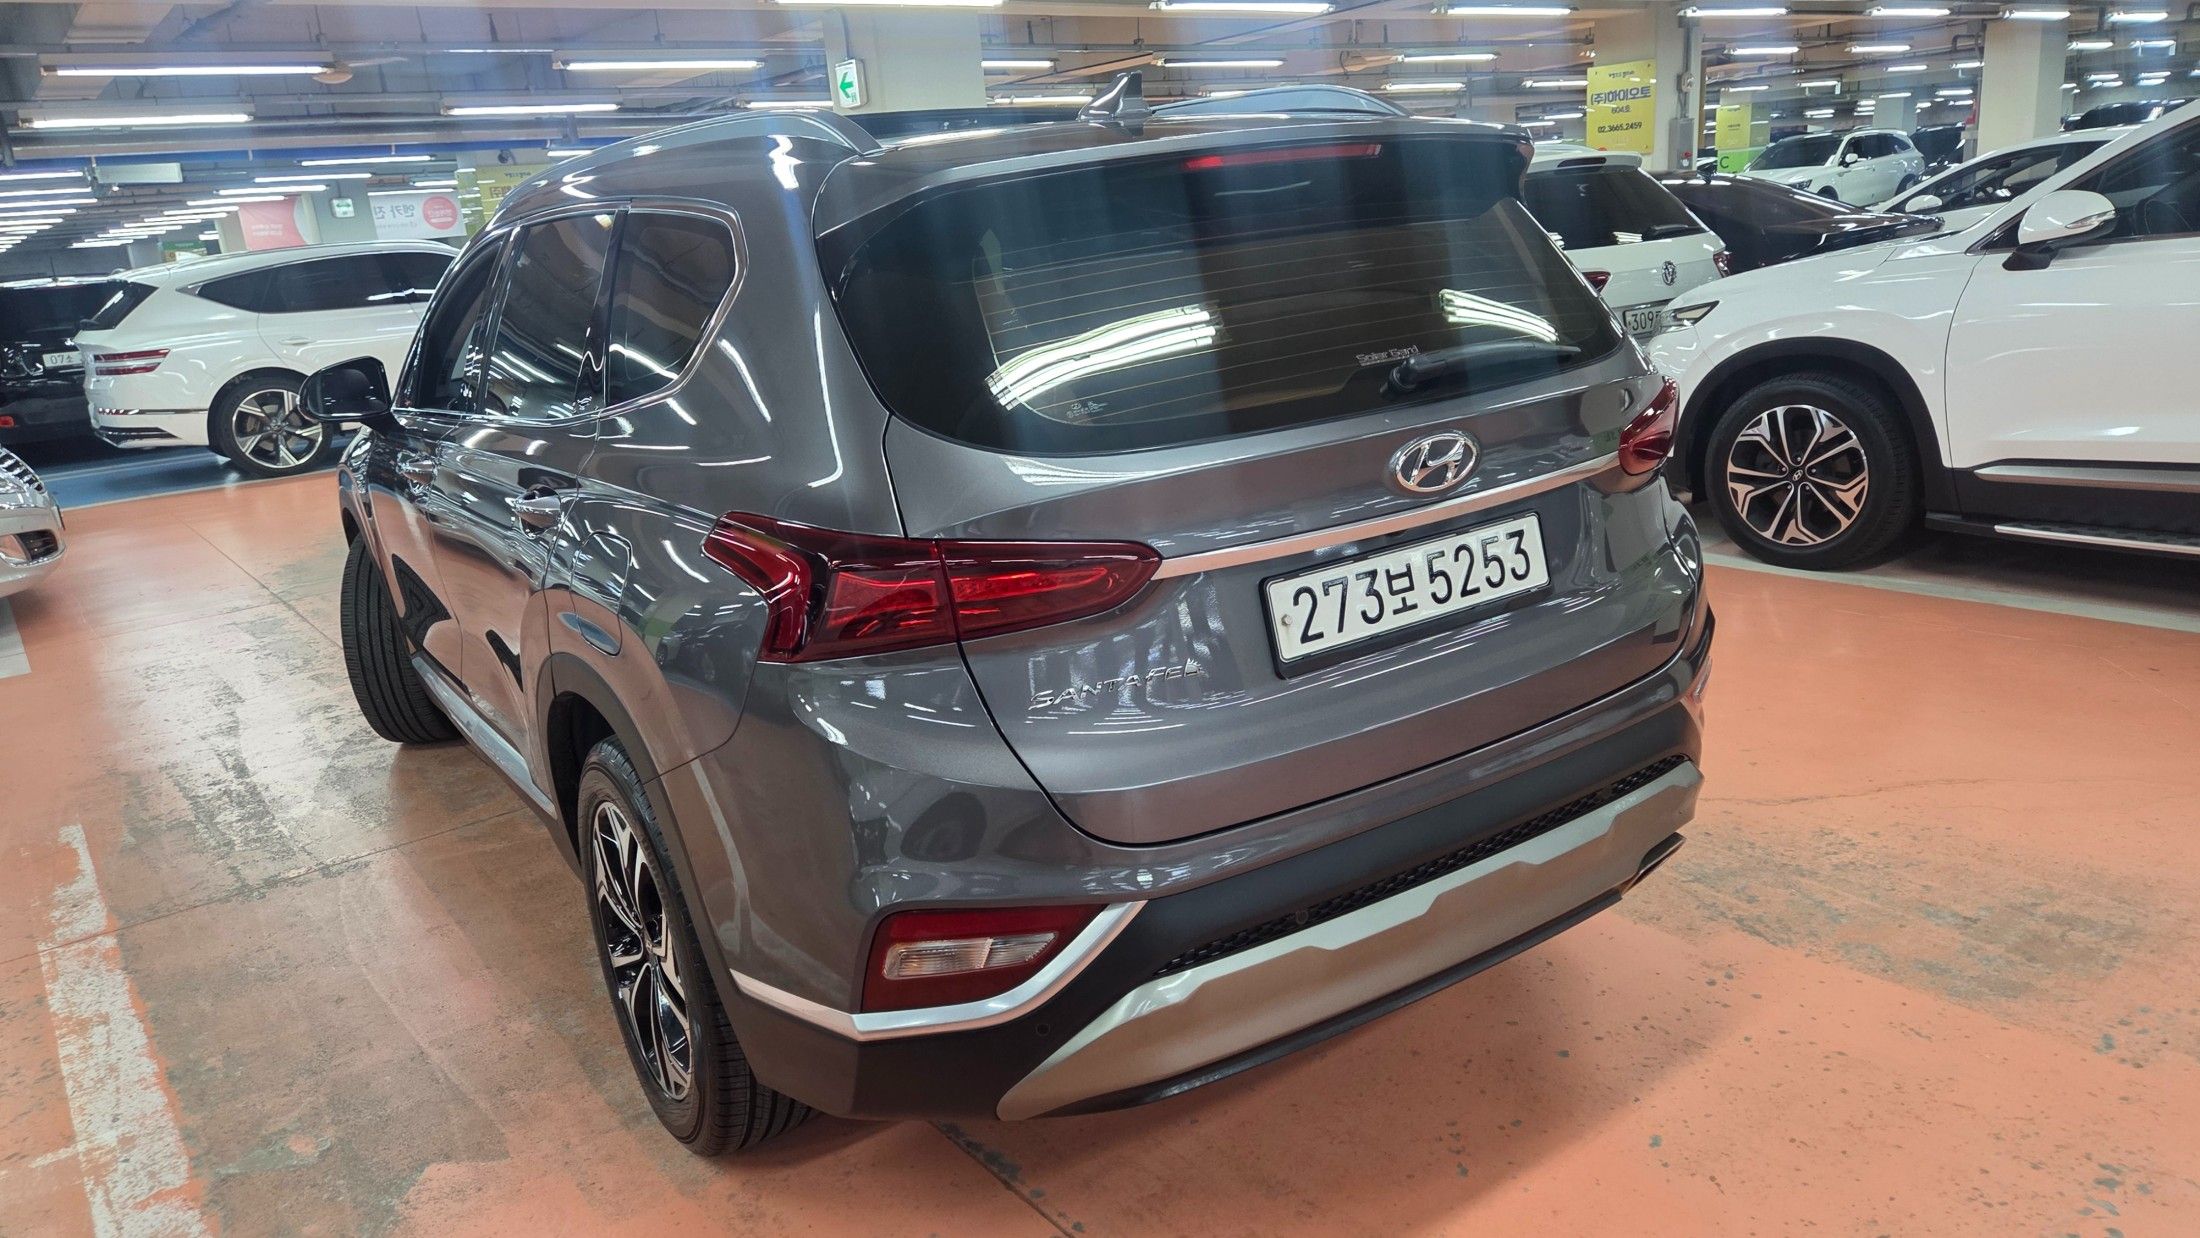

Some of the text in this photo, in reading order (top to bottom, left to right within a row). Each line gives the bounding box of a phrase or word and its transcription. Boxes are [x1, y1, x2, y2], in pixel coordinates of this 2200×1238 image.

[1597, 121, 1643, 134] 02.3665.2459
[1720, 156, 1730, 169] C
[1292, 529, 1532, 645] 273보 5253
